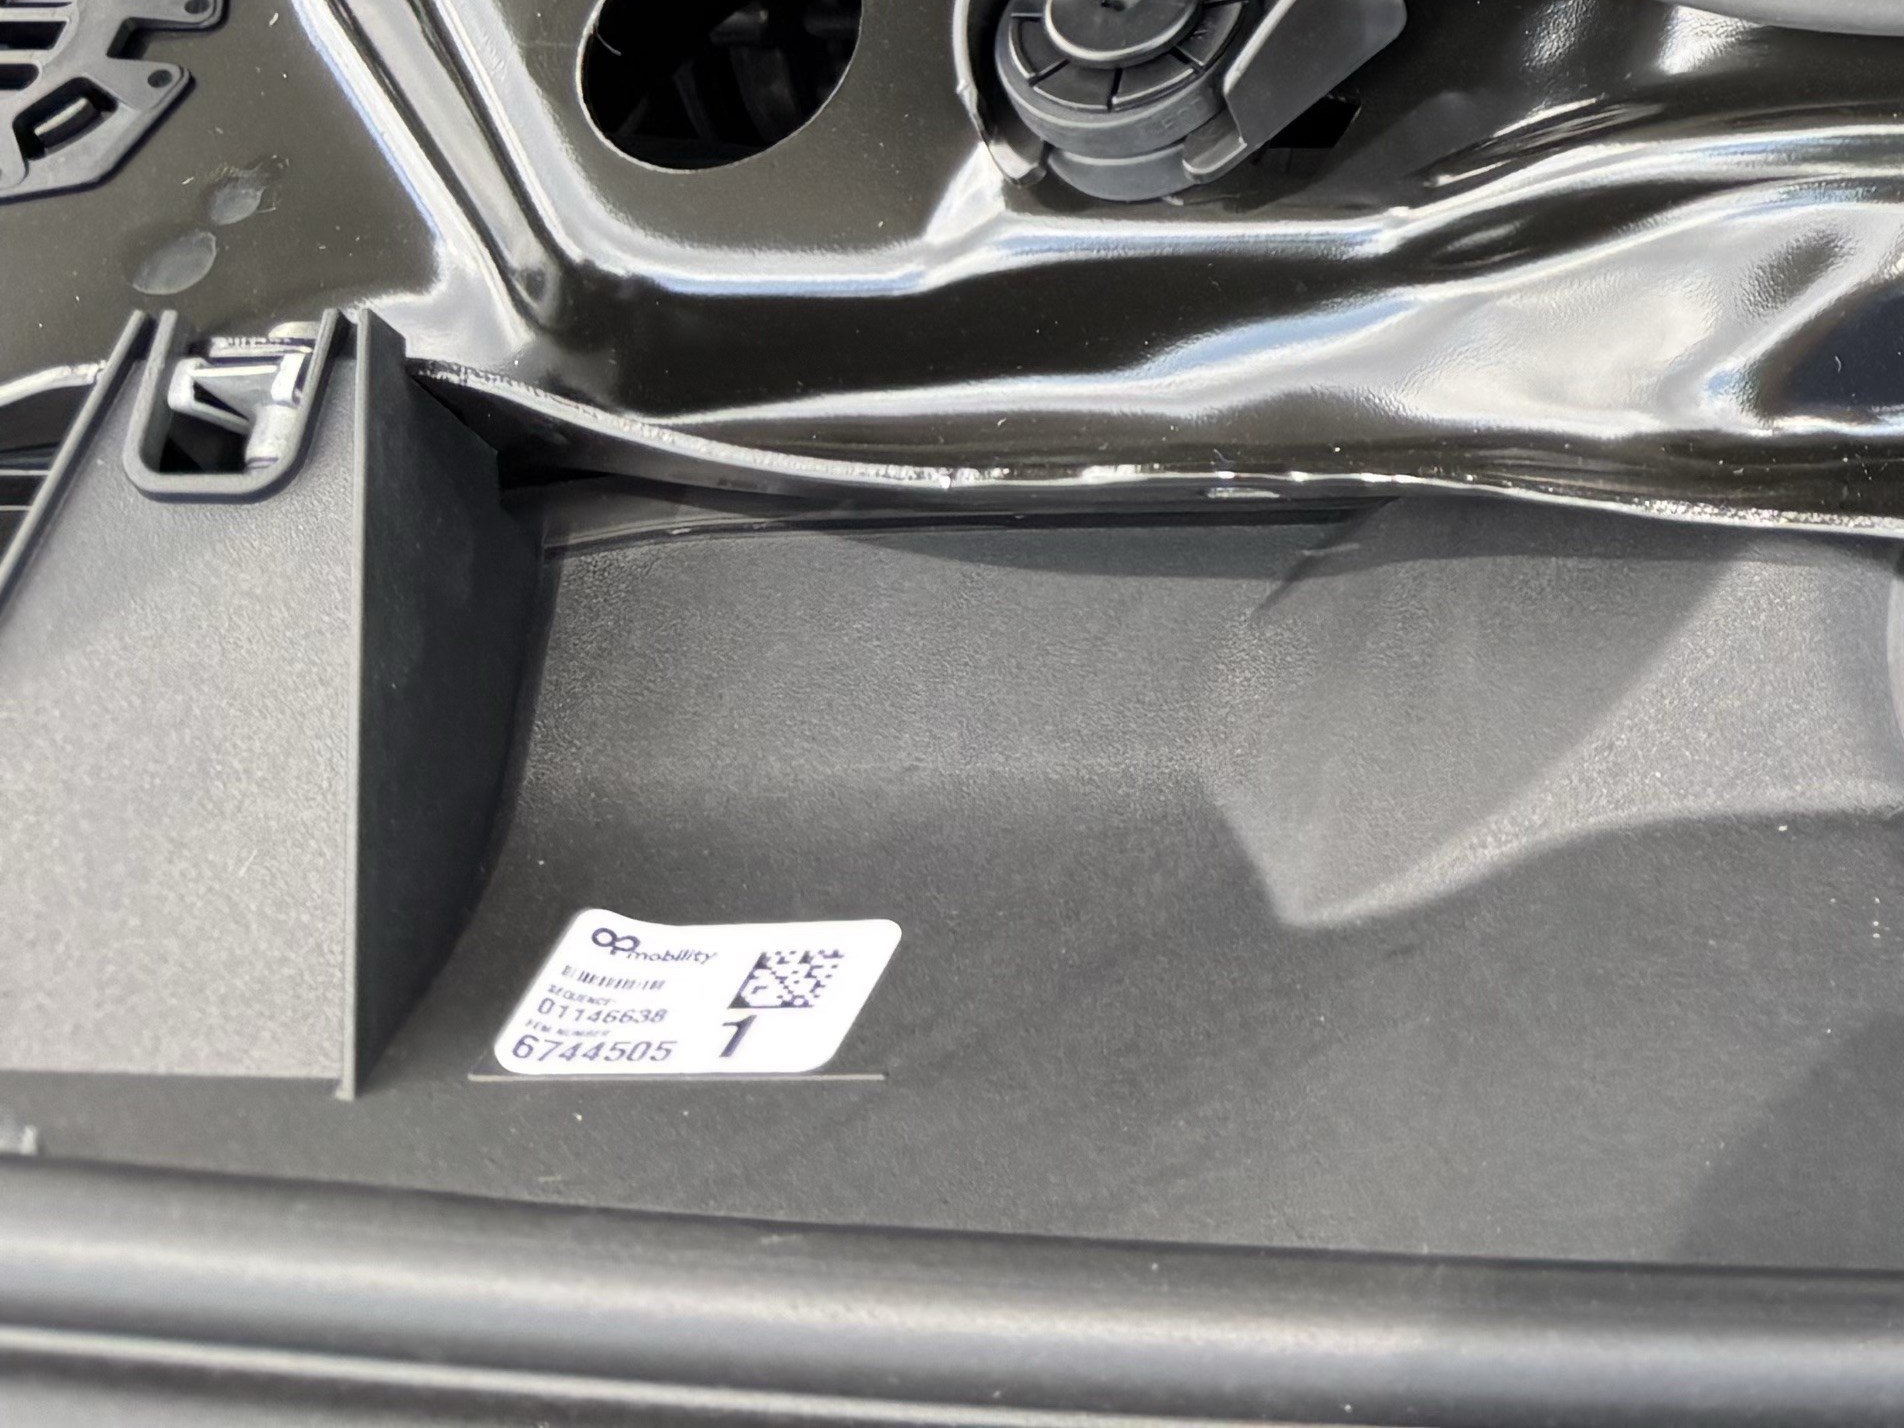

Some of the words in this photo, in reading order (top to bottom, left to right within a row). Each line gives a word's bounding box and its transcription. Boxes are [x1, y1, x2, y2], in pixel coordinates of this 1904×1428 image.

[537, 997, 668, 1024] 01146638
[511, 1032, 678, 1062] 6744505
[718, 1014, 759, 1059] 1
